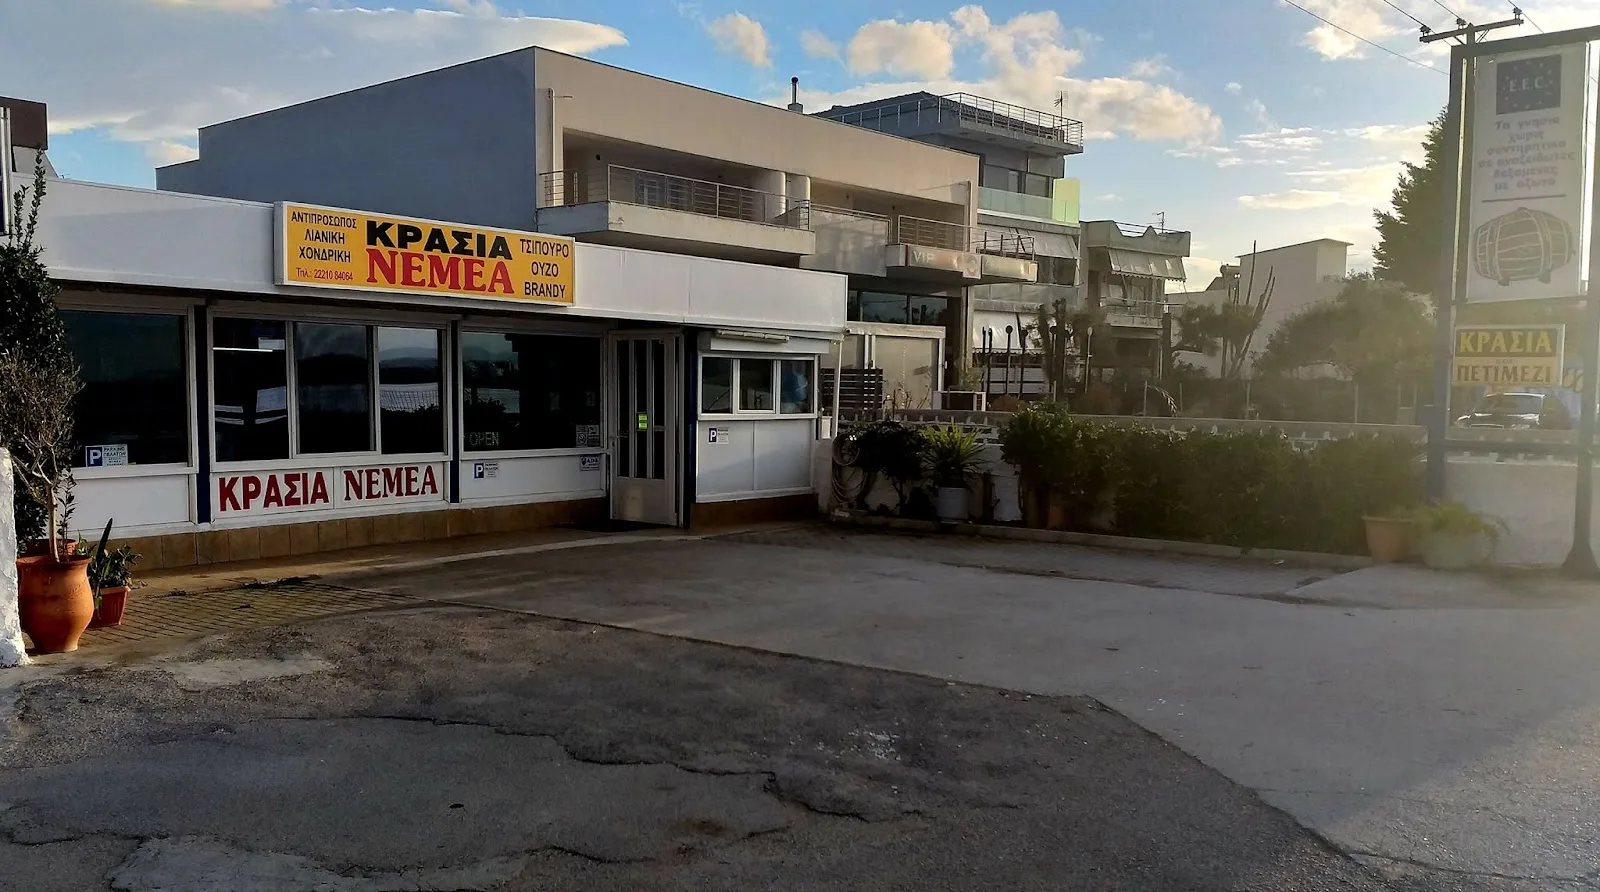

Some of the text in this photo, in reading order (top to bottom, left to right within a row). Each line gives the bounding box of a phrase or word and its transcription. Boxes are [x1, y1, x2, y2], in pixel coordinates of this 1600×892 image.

[291, 211, 357, 229] ΑΝΤΙΠΡΟΣΩΠΟΣ
[304, 228, 345, 244] ΛΙΑΝΙΚΗ
[366, 220, 513, 260] ΚΡΑΣΙΑ
[299, 246, 351, 263] ΧΟΝΔΡΙΚΗ
[520, 239, 569, 258] ΤΣΙΠΟΥΡΟ
[314, 269, 333, 280] 22210
[334, 270, 353, 281] 84064
[366, 248, 515, 294] ΝΕΜΕΑ
[531, 261, 559, 277] ΟΥΖΟ
[524, 282, 566, 298] BRANDY
[1460, 330, 1552, 353] ΚΡΑΣΙΑ
[1457, 365, 1552, 382] ΠΕΤΙΜΕΖΙ
[469, 431, 499, 446] OPEN
[90, 449, 101, 464] P
[476, 464, 483, 477] P
[219, 465, 438, 512] ΚΡΑΣΙΑ ΝΕΜΕΑ
